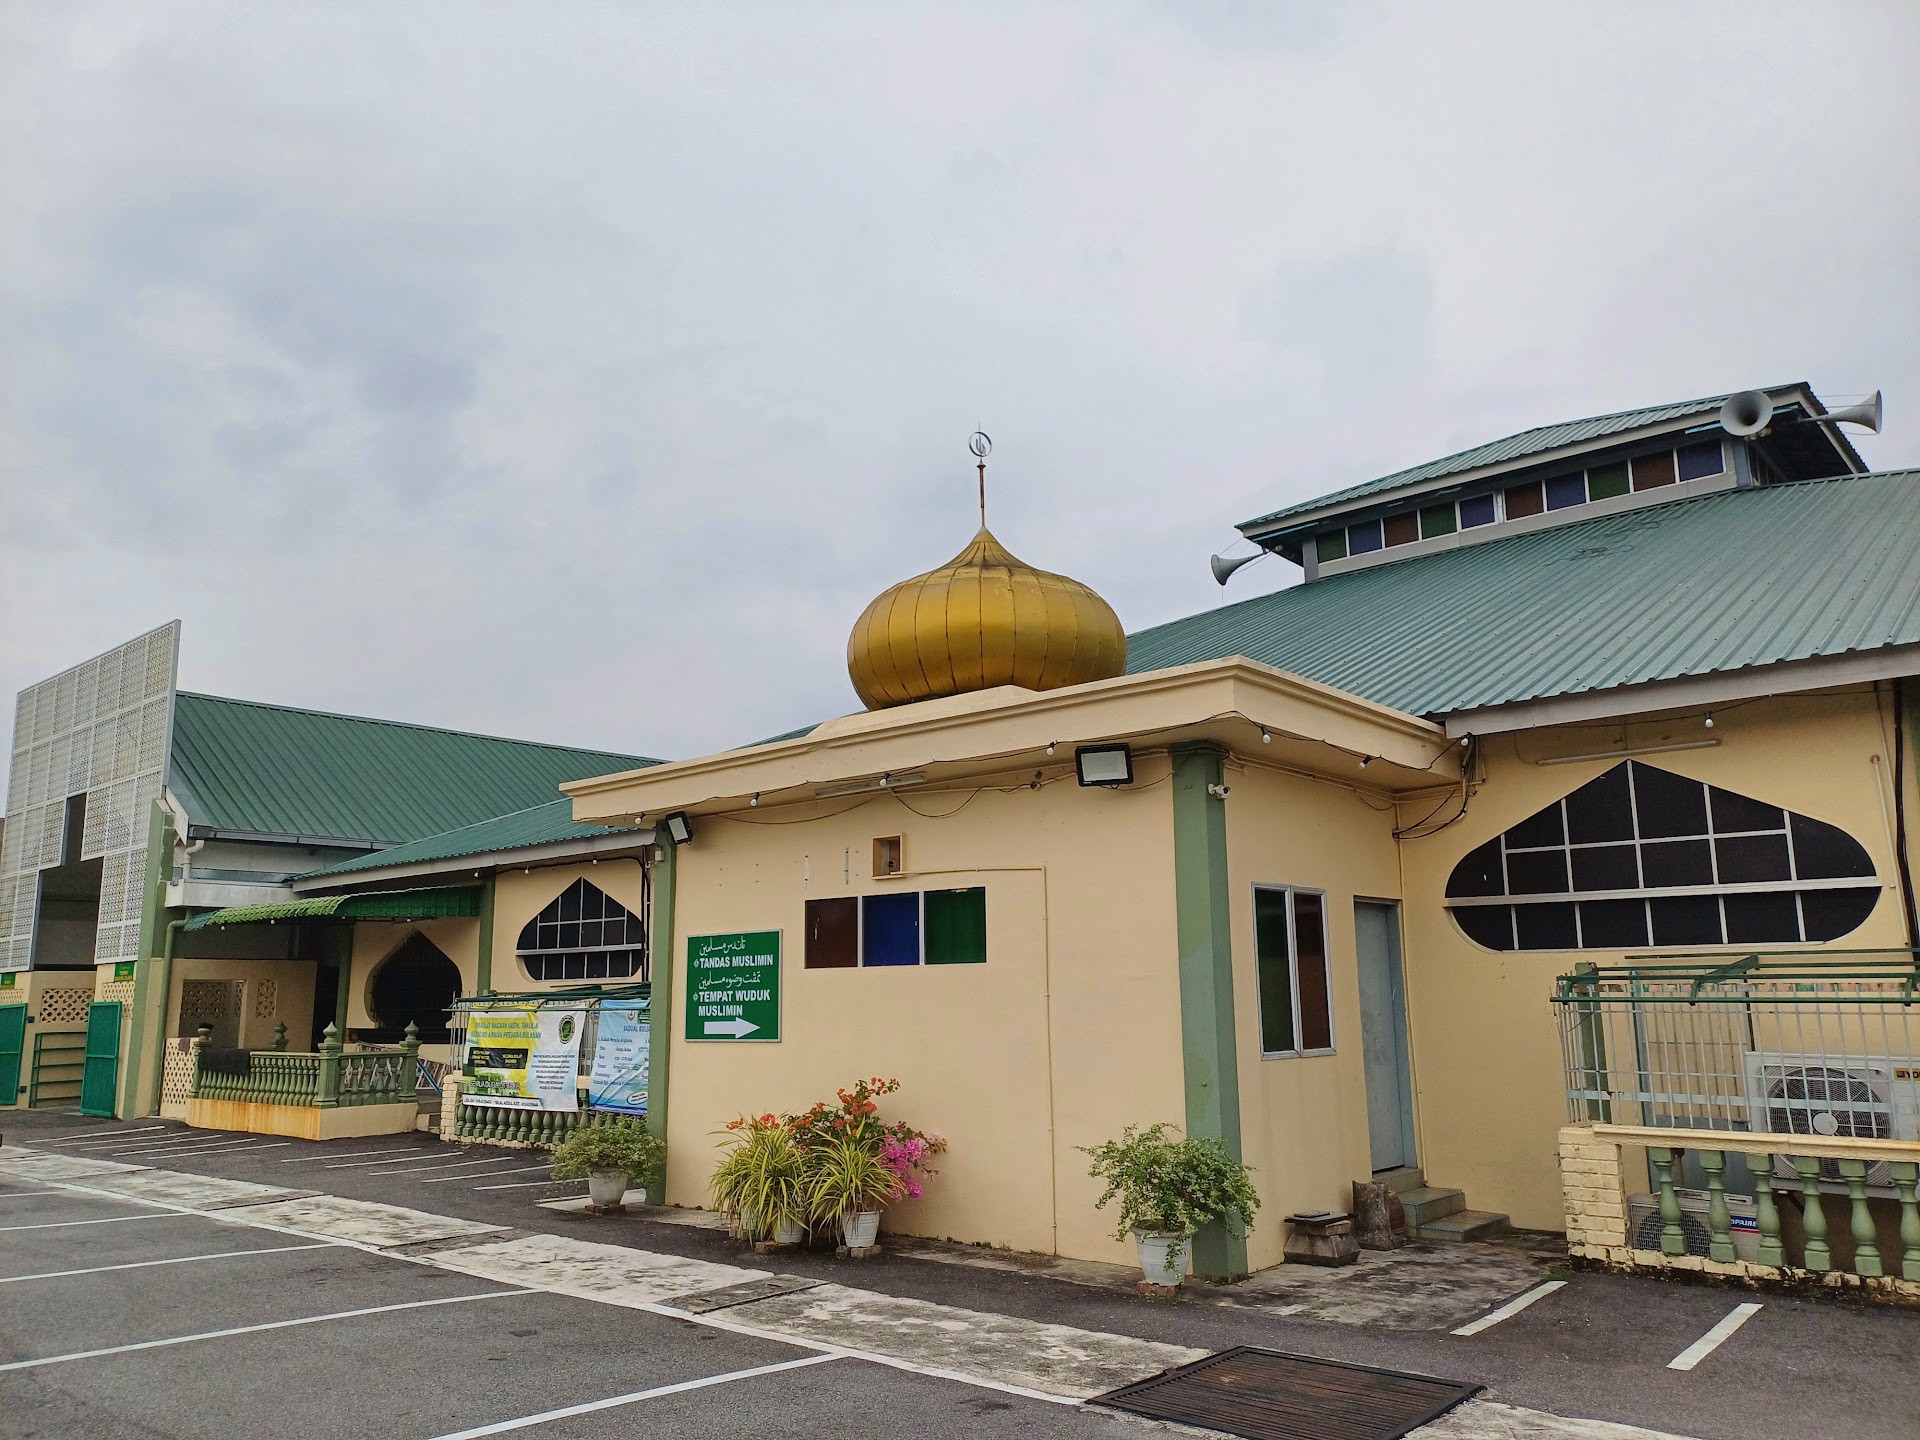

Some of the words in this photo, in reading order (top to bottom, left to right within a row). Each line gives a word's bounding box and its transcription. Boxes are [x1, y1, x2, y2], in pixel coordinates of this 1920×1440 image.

[699, 956, 730, 969] TANDAS
[732, 954, 773, 967] MUSLIMIN
[698, 990, 733, 1002] TEMPAT
[735, 989, 771, 1002] WUDUK
[698, 1004, 743, 1016] MUSLIMIN
